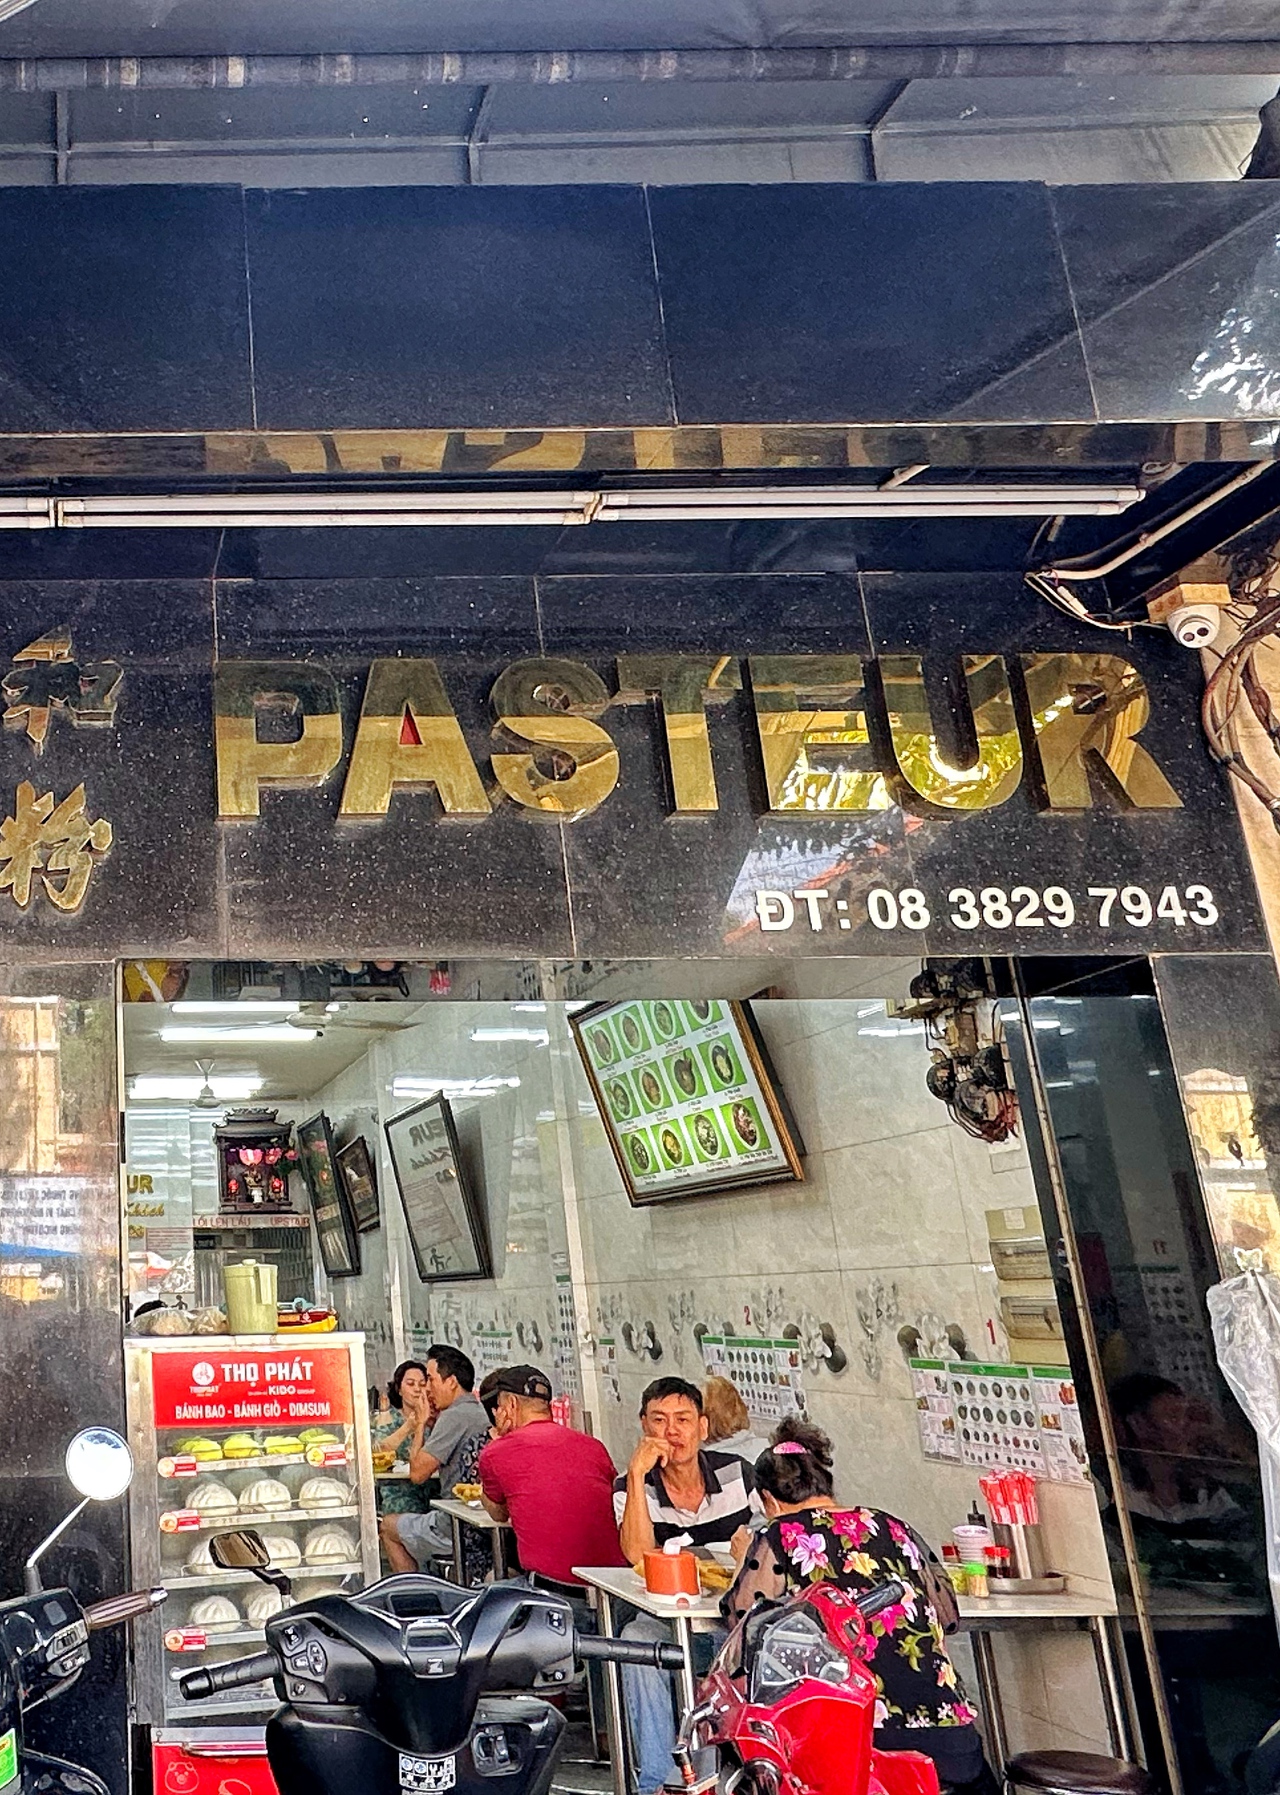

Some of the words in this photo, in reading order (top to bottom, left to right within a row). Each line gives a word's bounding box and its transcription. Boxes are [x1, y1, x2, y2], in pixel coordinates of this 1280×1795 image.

[214, 653, 1184, 823] PASTEUR
[756, 889, 850, 932] ĐT:
[868, 888, 930, 931] 08
[950, 886, 1074, 930] 3829
[1088, 885, 1219, 930] 7943
[743, 1305, 752, 1326] 2
[986, 1318, 996, 1345] 1
[220, 1362, 260, 1387] THỌ
[264, 1356, 314, 1382] PHÁT
[268, 1385, 297, 1396] KIDO
[175, 1402, 204, 1419] BÁNH
[205, 1405, 226, 1419] BAO
[233, 1401, 262, 1418] BÁNH
[289, 1402, 331, 1417] DIMSUM
